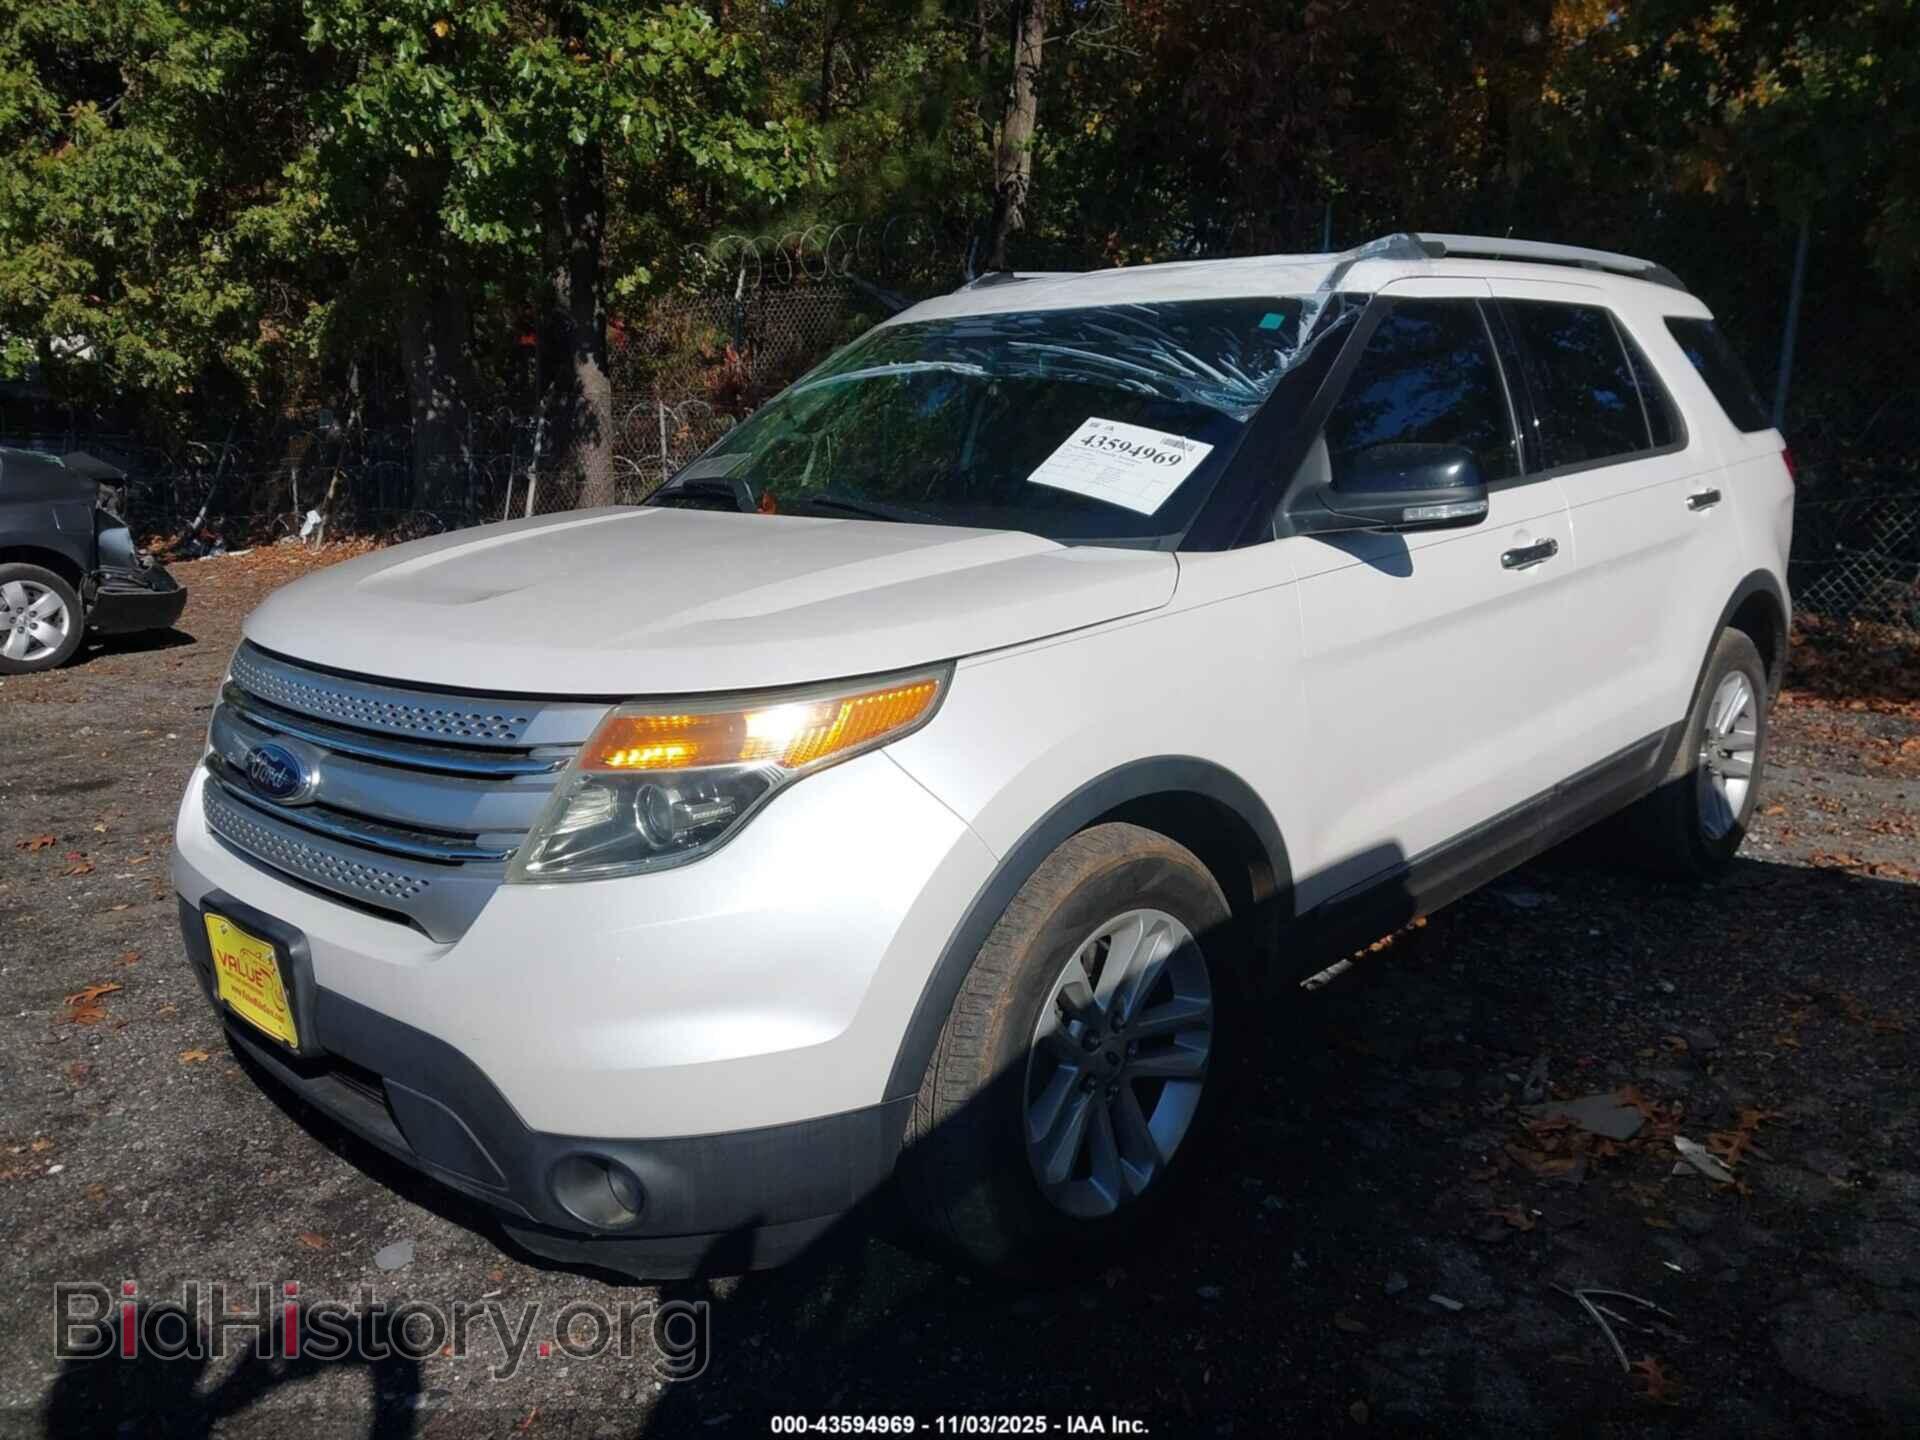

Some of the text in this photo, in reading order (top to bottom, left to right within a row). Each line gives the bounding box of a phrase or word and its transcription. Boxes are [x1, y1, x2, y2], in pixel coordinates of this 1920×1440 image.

[1080, 433, 1182, 467] 43594969
[252, 750, 288, 789] Ford
[216, 949, 265, 988] VALUE
